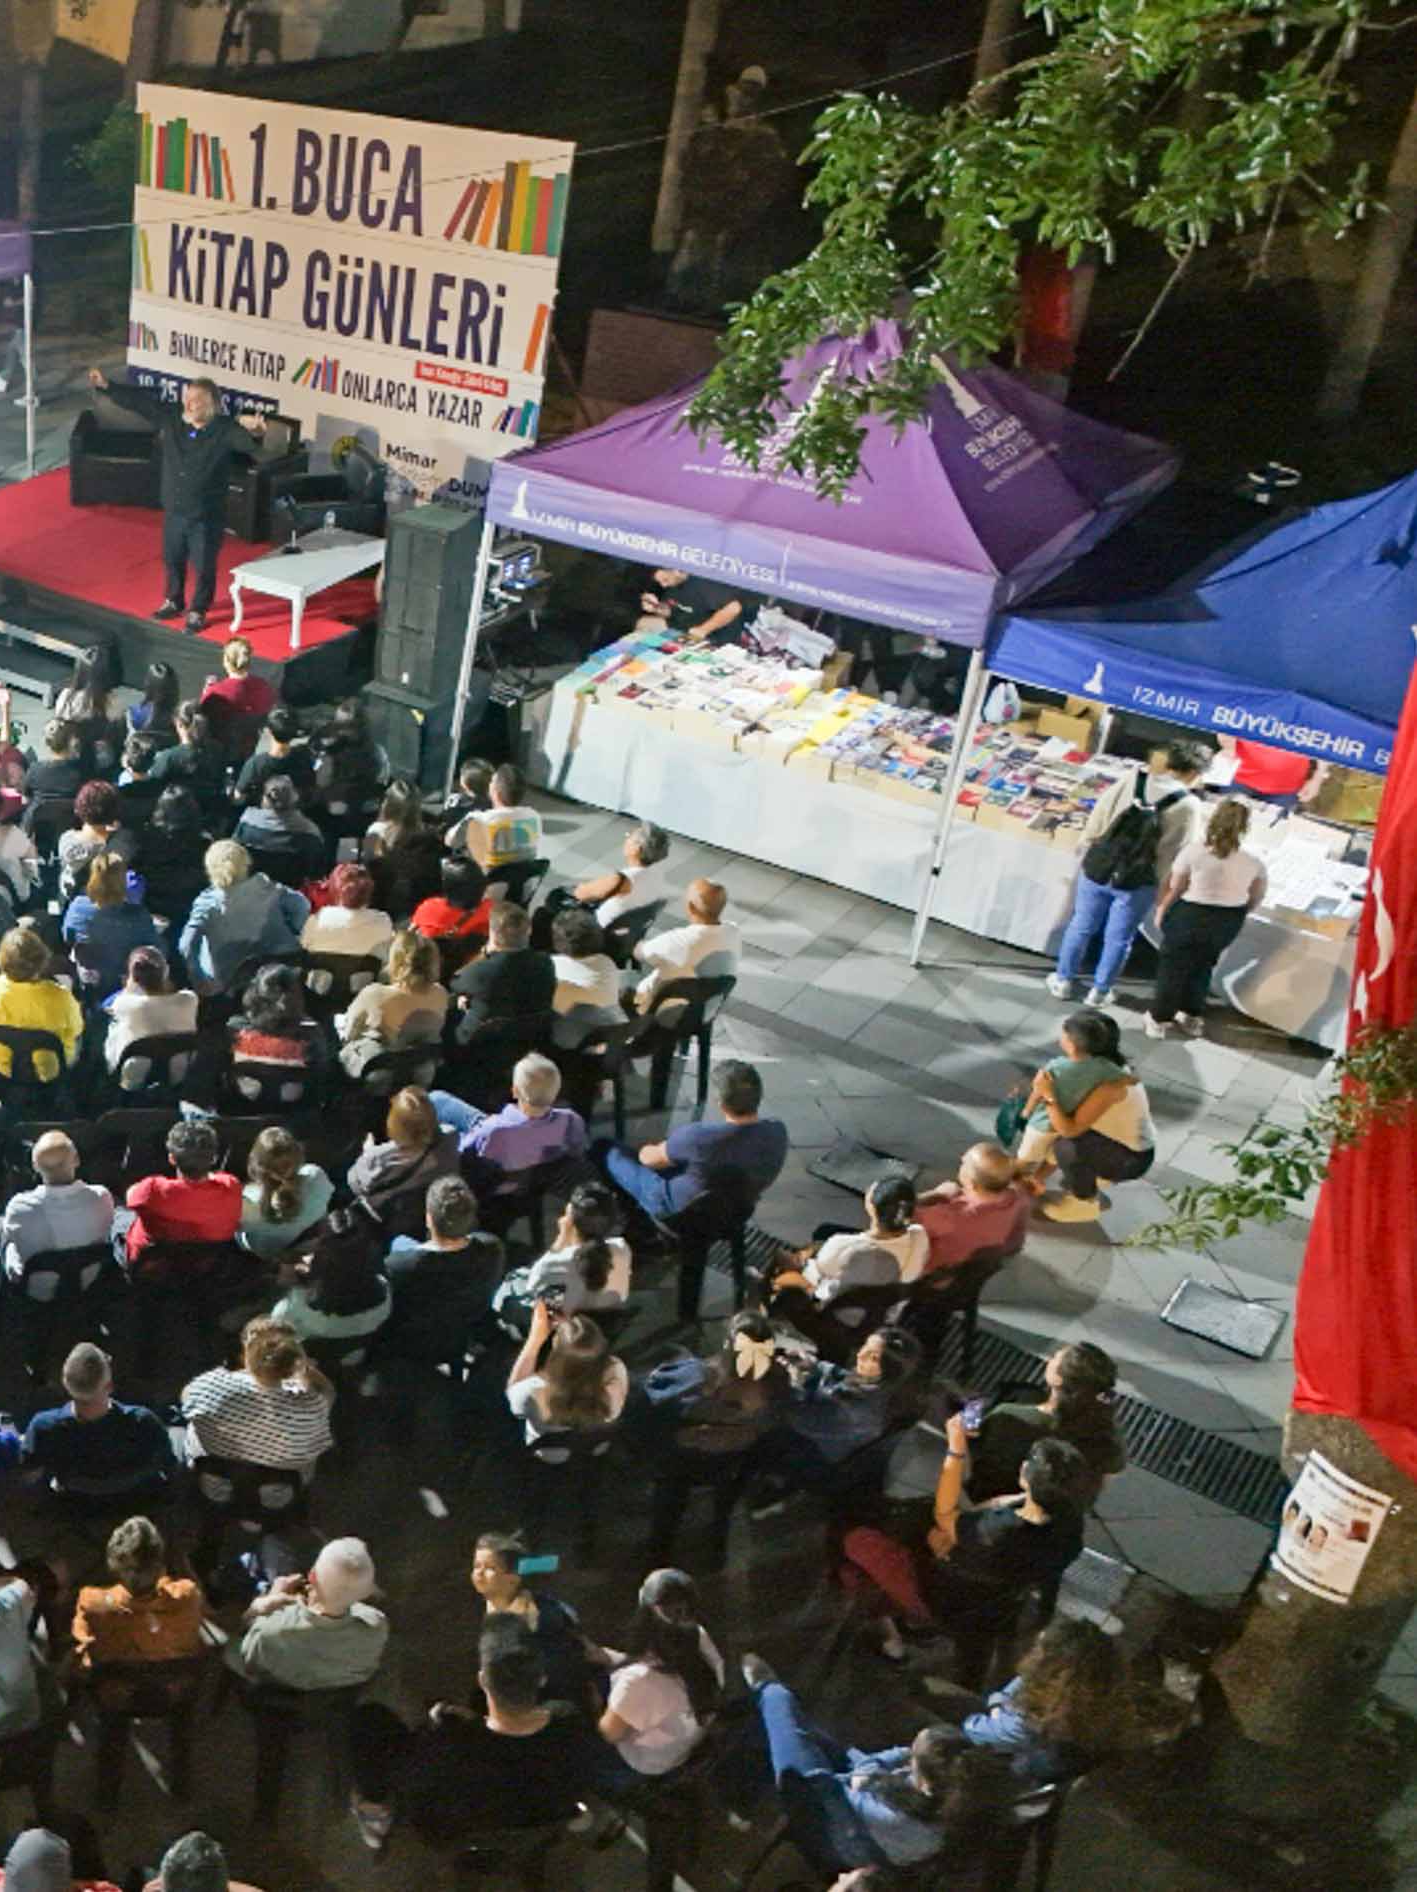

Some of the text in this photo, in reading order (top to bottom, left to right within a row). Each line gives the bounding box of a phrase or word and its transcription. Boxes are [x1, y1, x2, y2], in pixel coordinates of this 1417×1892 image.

[249, 122, 424, 237] 1. BUCA
[341, 369, 418, 415] ONLARCA
[426, 389, 483, 430] YAZAR
[385, 443, 438, 469] Mimar
